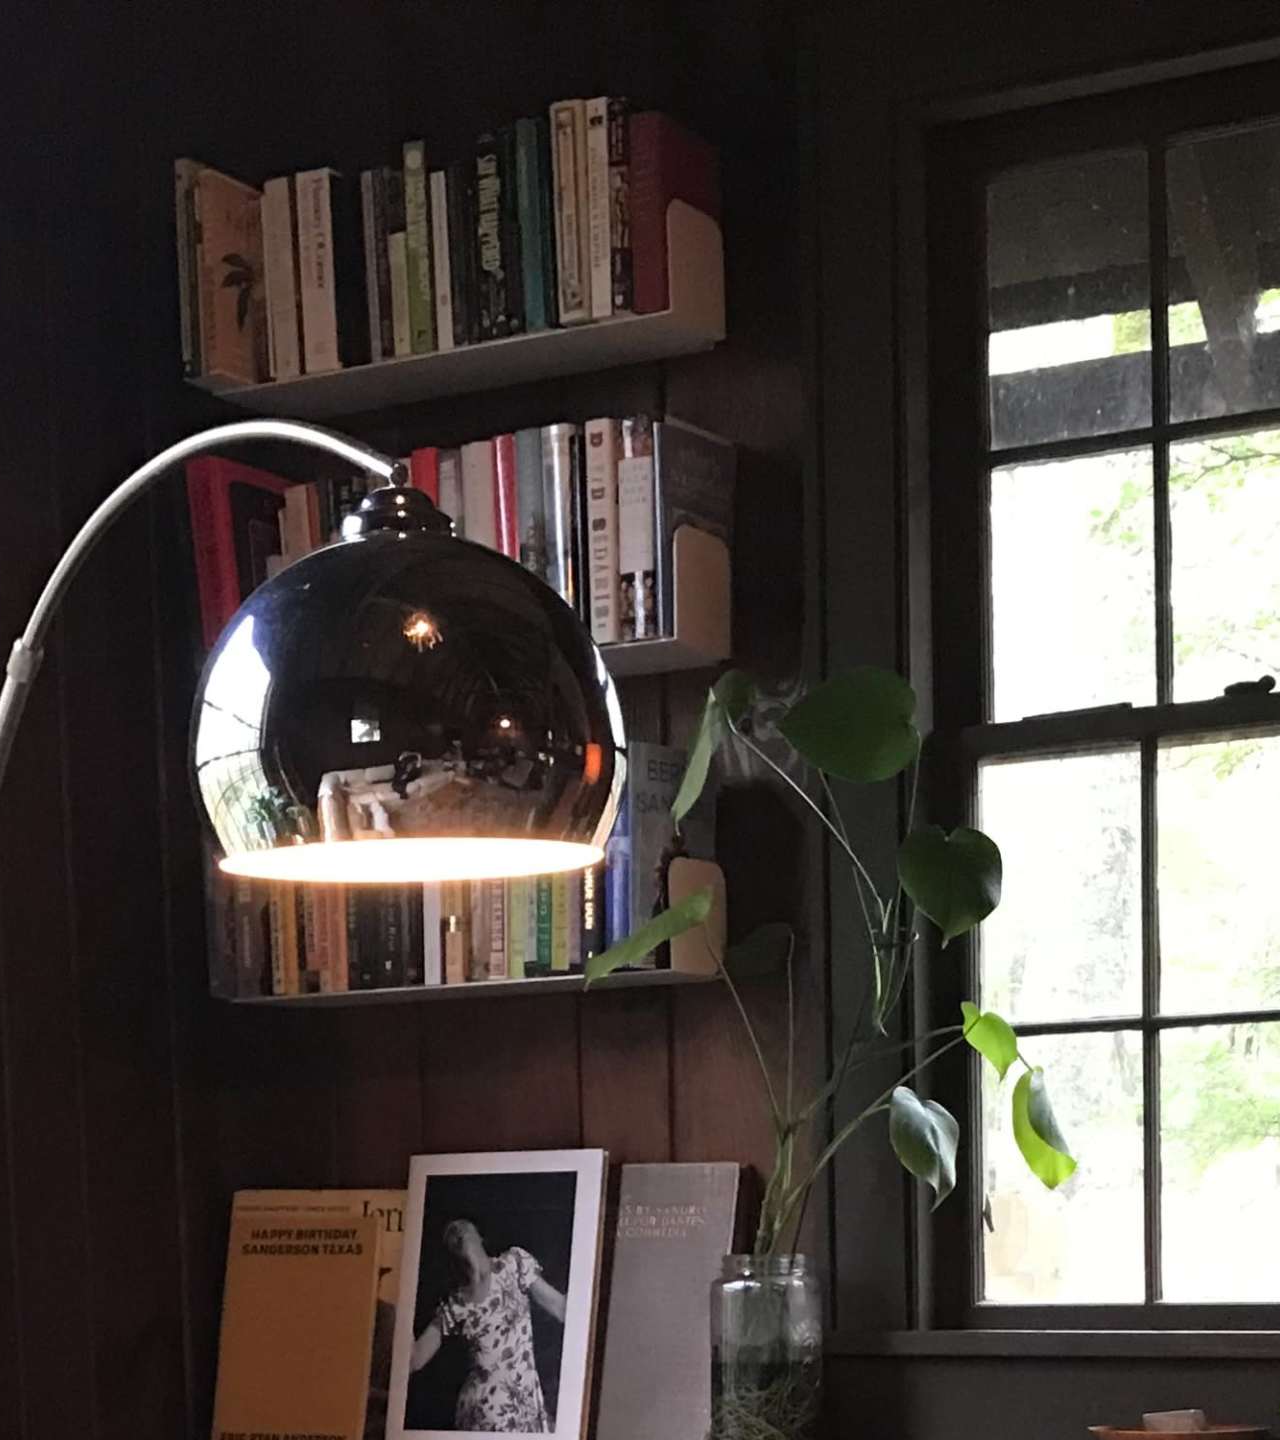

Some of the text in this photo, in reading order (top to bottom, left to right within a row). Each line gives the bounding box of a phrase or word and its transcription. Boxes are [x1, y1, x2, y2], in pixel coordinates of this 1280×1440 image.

[250, 1228, 358, 1242] HAPPY BIRTHDAY
[241, 1242, 363, 1257] SANDERSON TEXAS
